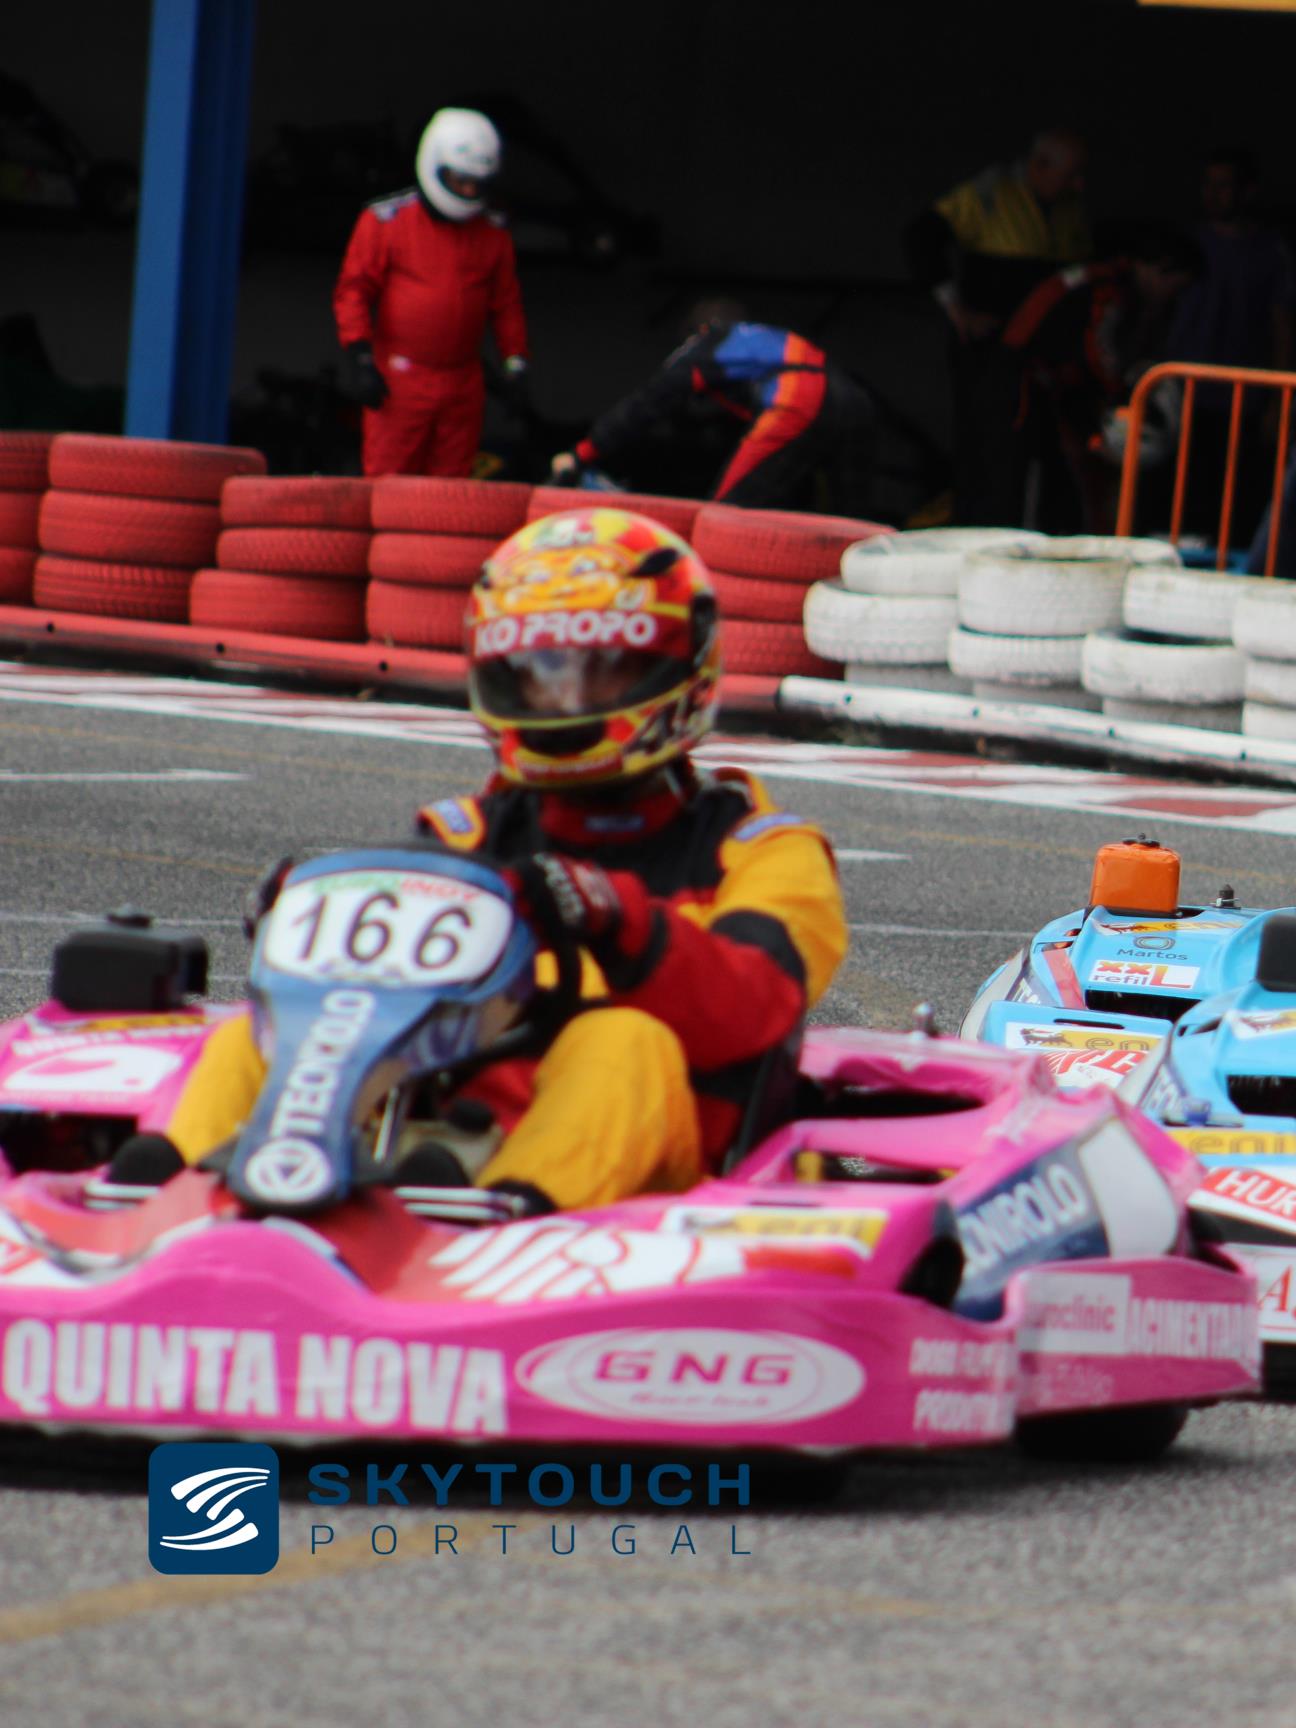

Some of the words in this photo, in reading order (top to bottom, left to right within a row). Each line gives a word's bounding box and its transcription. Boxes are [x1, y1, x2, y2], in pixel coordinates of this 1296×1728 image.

[520, 609, 657, 647] PROPO
[290, 890, 473, 971] 166
[1116, 947, 1189, 961] Martos
[1092, 972, 1148, 986] refil
[2, 1318, 281, 1417] QUINTA
[294, 1332, 509, 1435] NOVA
[593, 1350, 796, 1387] GNG
